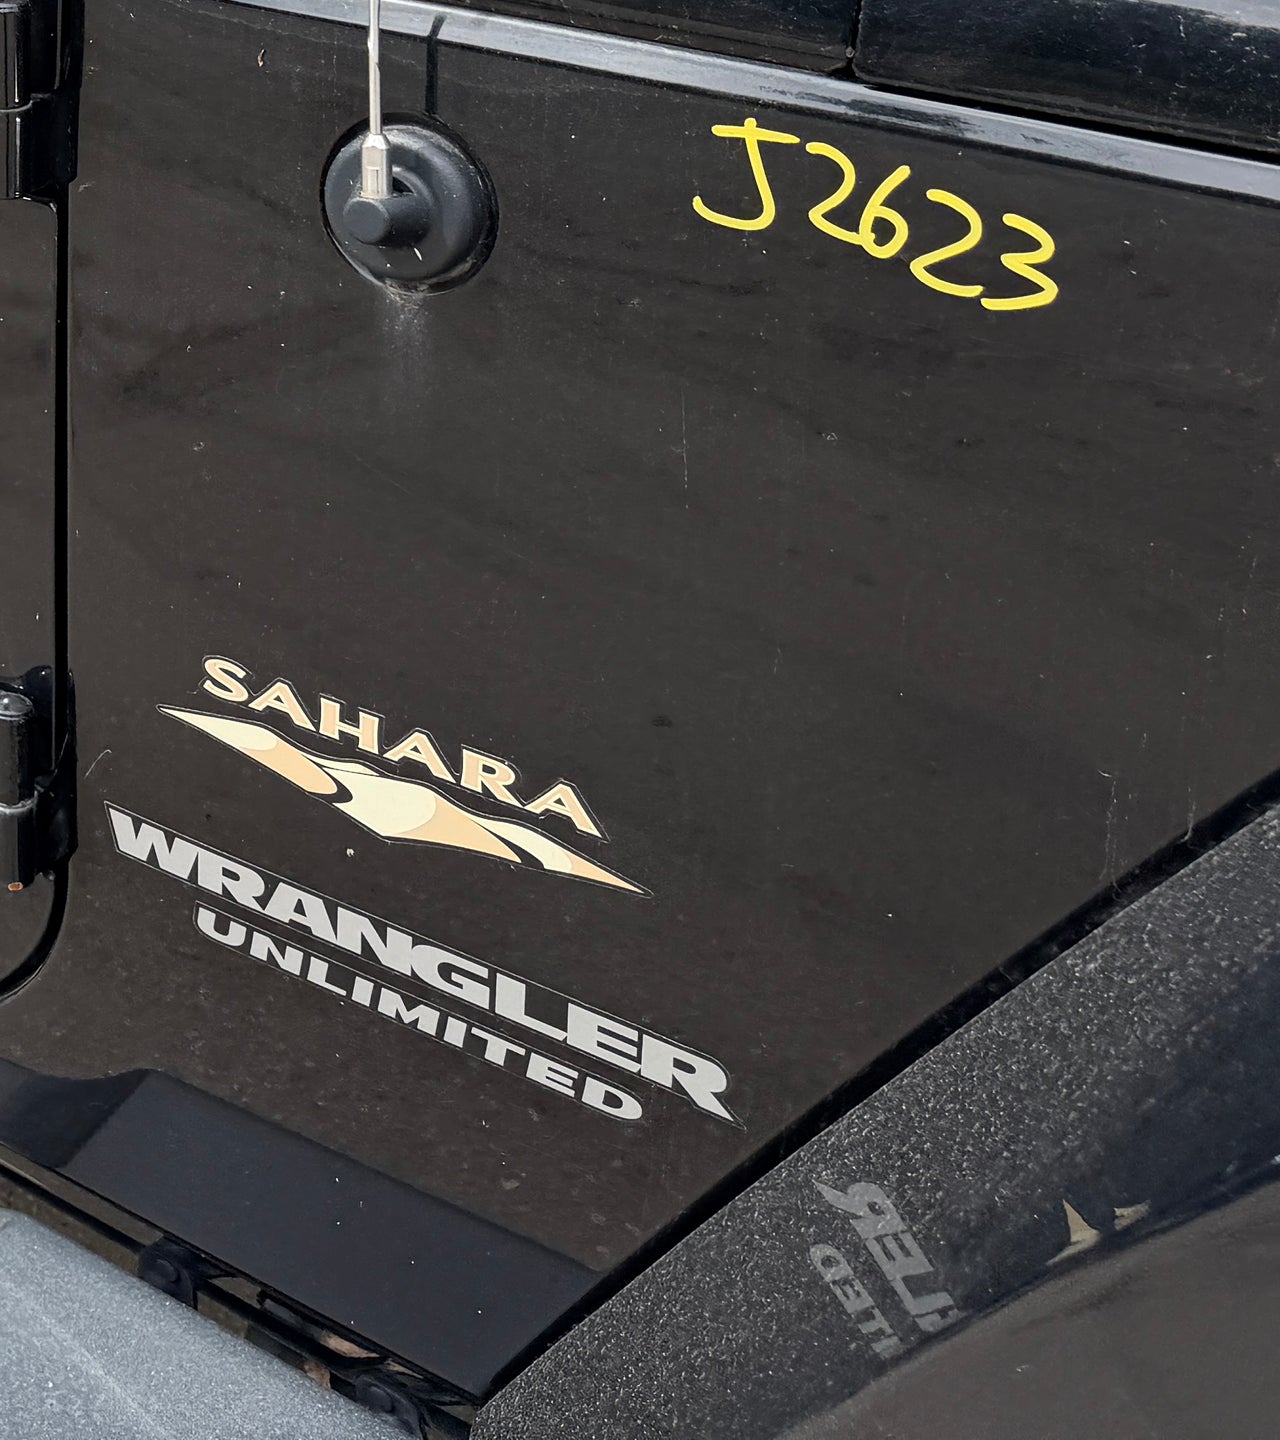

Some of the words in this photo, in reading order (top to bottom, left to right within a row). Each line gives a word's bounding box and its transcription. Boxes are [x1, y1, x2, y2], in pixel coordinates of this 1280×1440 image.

[692, 118, 1059, 310] J2623
[202, 658, 604, 838] SAHARA
[107, 806, 739, 1126] WRANGLER
[196, 907, 643, 1120] UNLIMITED
